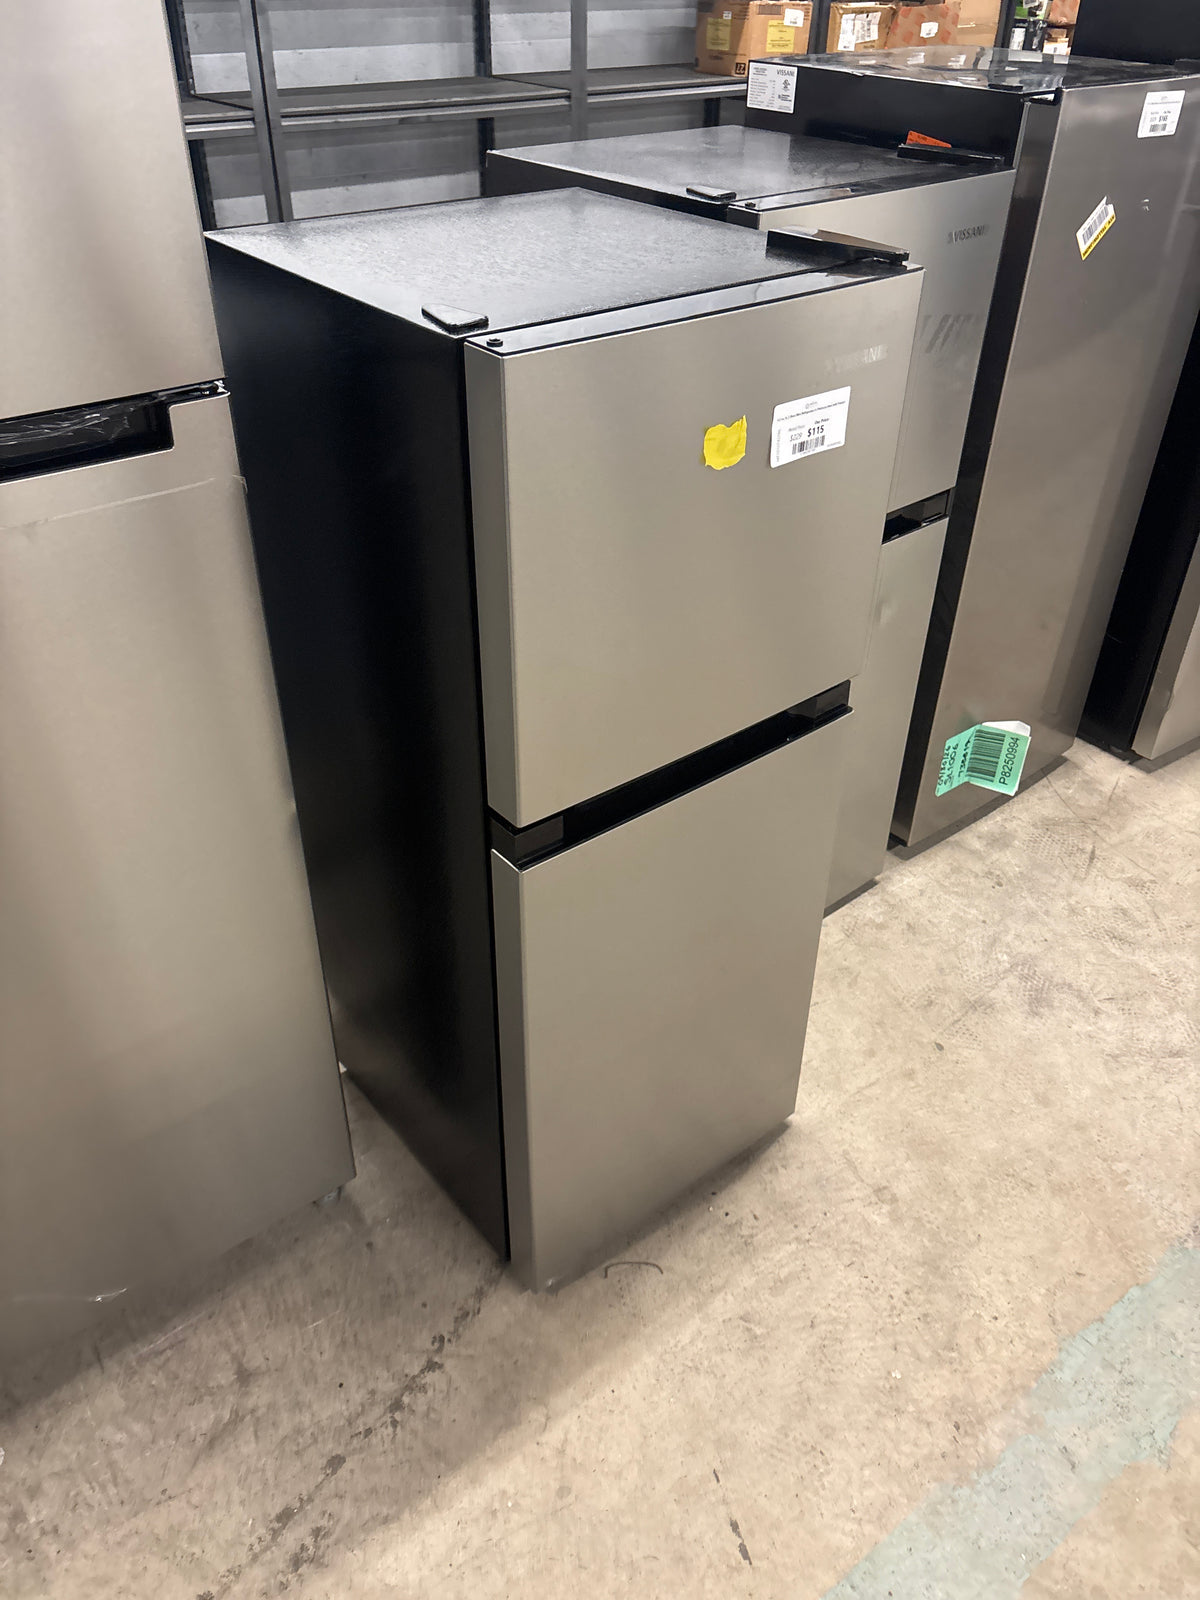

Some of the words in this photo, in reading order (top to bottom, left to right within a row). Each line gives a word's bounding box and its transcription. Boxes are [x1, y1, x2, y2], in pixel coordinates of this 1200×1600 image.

[777, 69, 795, 77] VISSANI
[951, 225, 987, 244] VISSANI
[807, 425, 825, 437] $115
[999, 737, 1020, 786] P8250994
